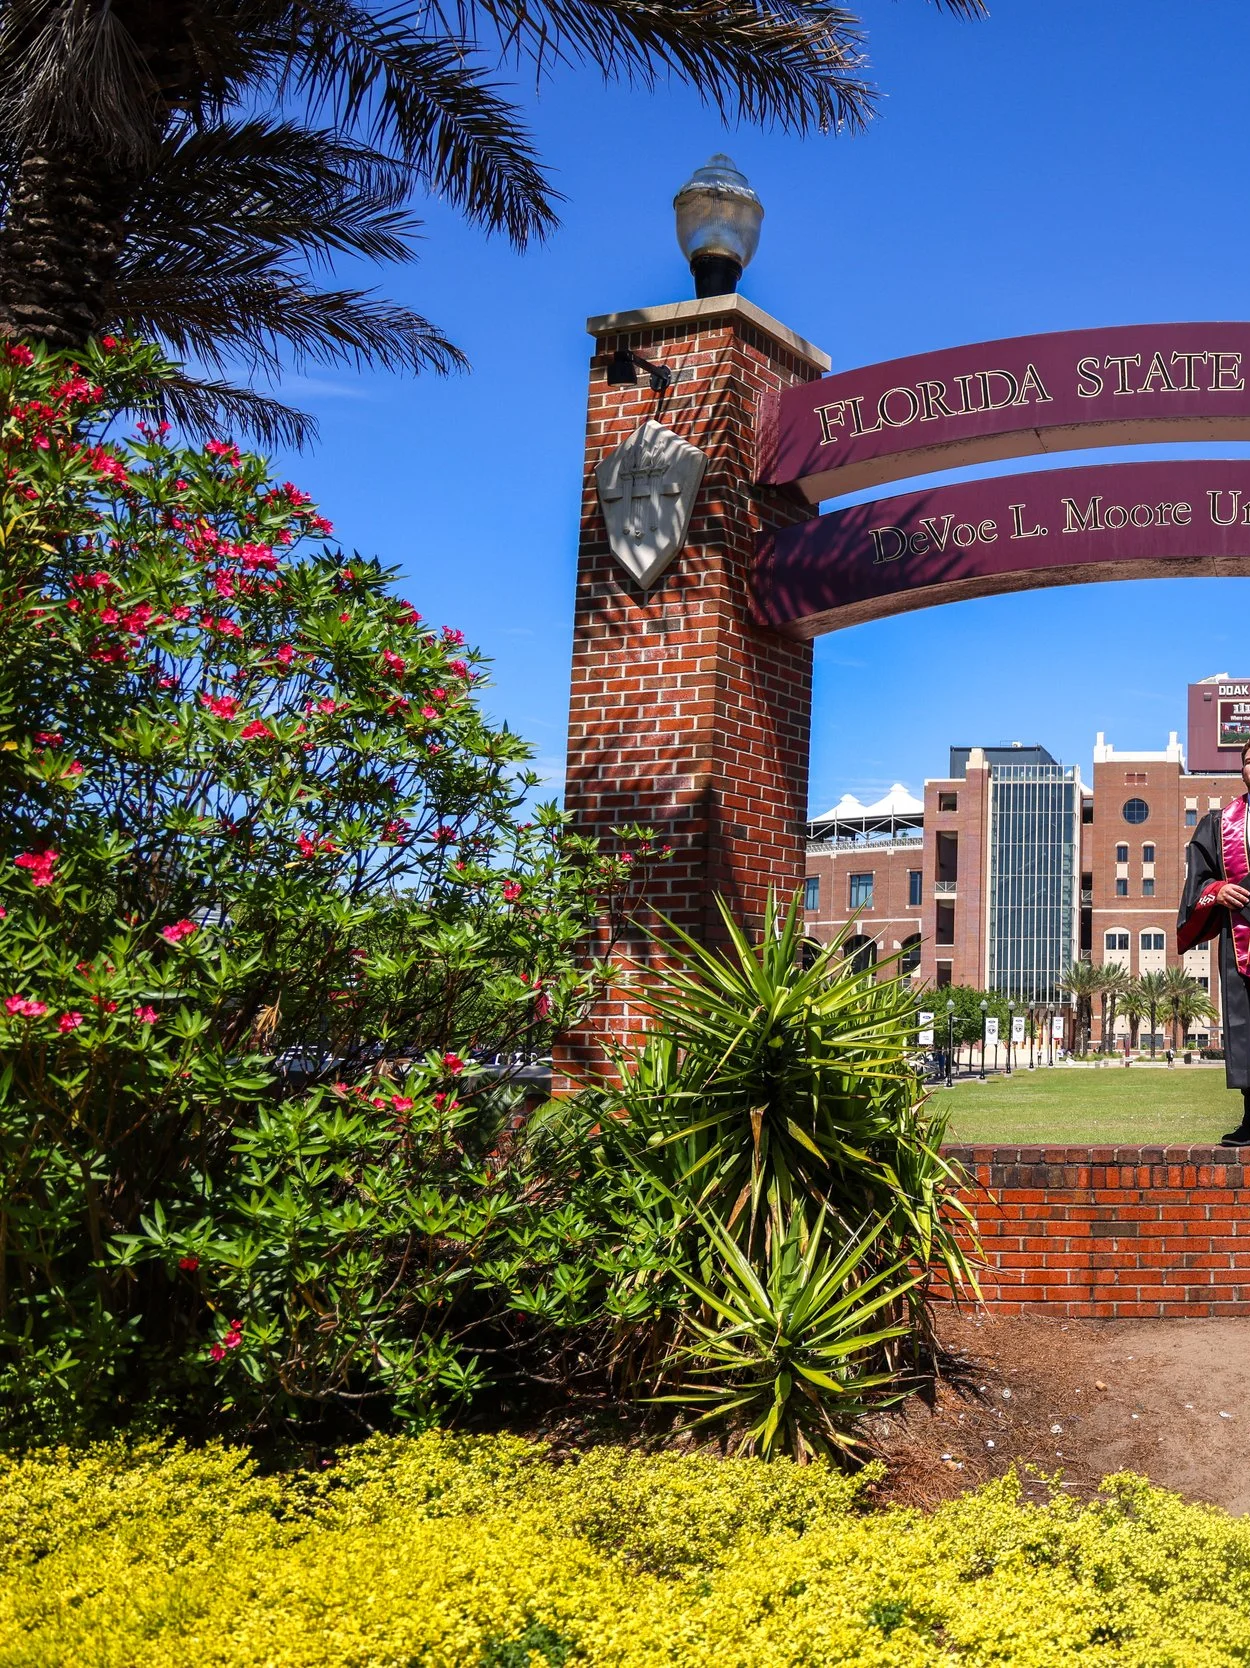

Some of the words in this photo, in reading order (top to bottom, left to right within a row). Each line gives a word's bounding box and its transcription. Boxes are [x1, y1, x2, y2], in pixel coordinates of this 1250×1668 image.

[814, 363, 1053, 446] FLORIDA
[1076, 350, 1246, 399] STATE
[868, 513, 999, 565] DeVoe
[1009, 503, 1049, 539] L.
[1062, 495, 1192, 533] Moore
[1218, 685, 1249, 695] DOAK
